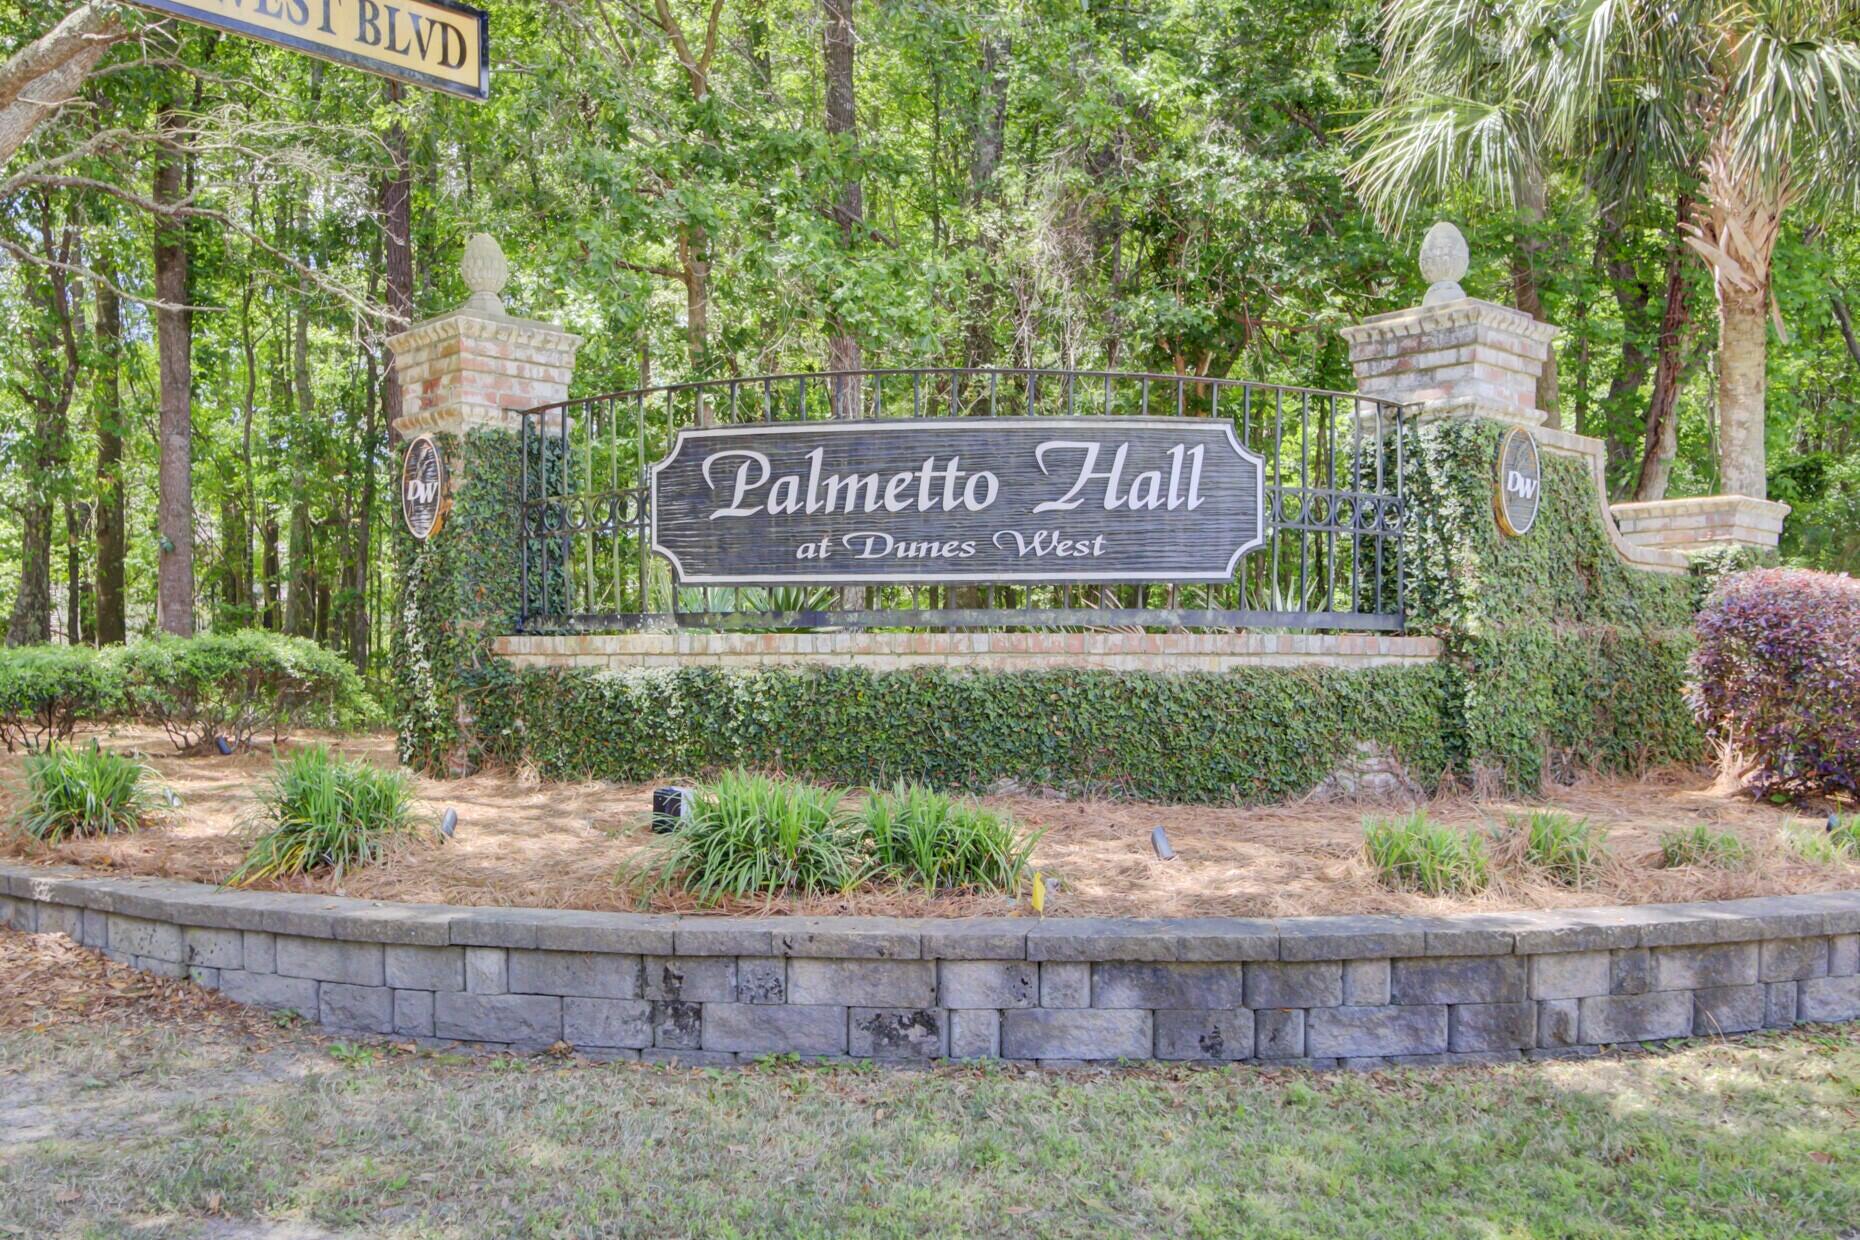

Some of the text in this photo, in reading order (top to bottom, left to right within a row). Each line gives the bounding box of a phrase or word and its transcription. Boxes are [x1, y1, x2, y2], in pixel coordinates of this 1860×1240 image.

[219, 0, 467, 70] ST BLVD
[407, 479, 438, 504] DW
[702, 440, 1205, 521] Palmetto Hall
[1507, 470, 1537, 499] DW
[796, 530, 1106, 560] at Dunes West
